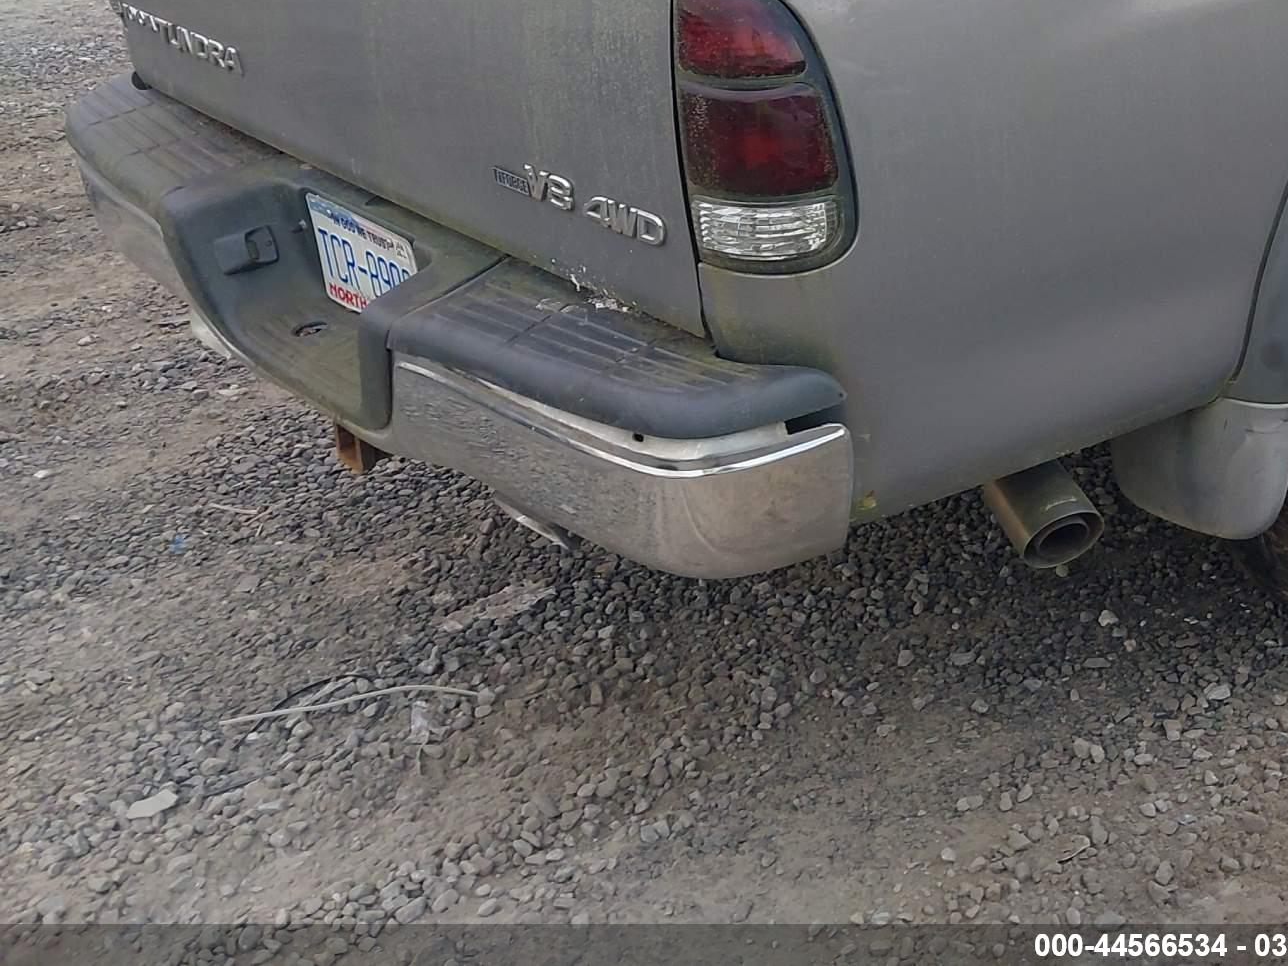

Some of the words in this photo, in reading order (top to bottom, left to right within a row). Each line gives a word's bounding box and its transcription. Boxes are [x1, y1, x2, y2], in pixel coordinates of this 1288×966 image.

[156, 17, 244, 75] TUNDRA
[523, 163, 575, 211] V8
[583, 195, 666, 247] 4WD
[328, 282, 368, 310] NORTH
